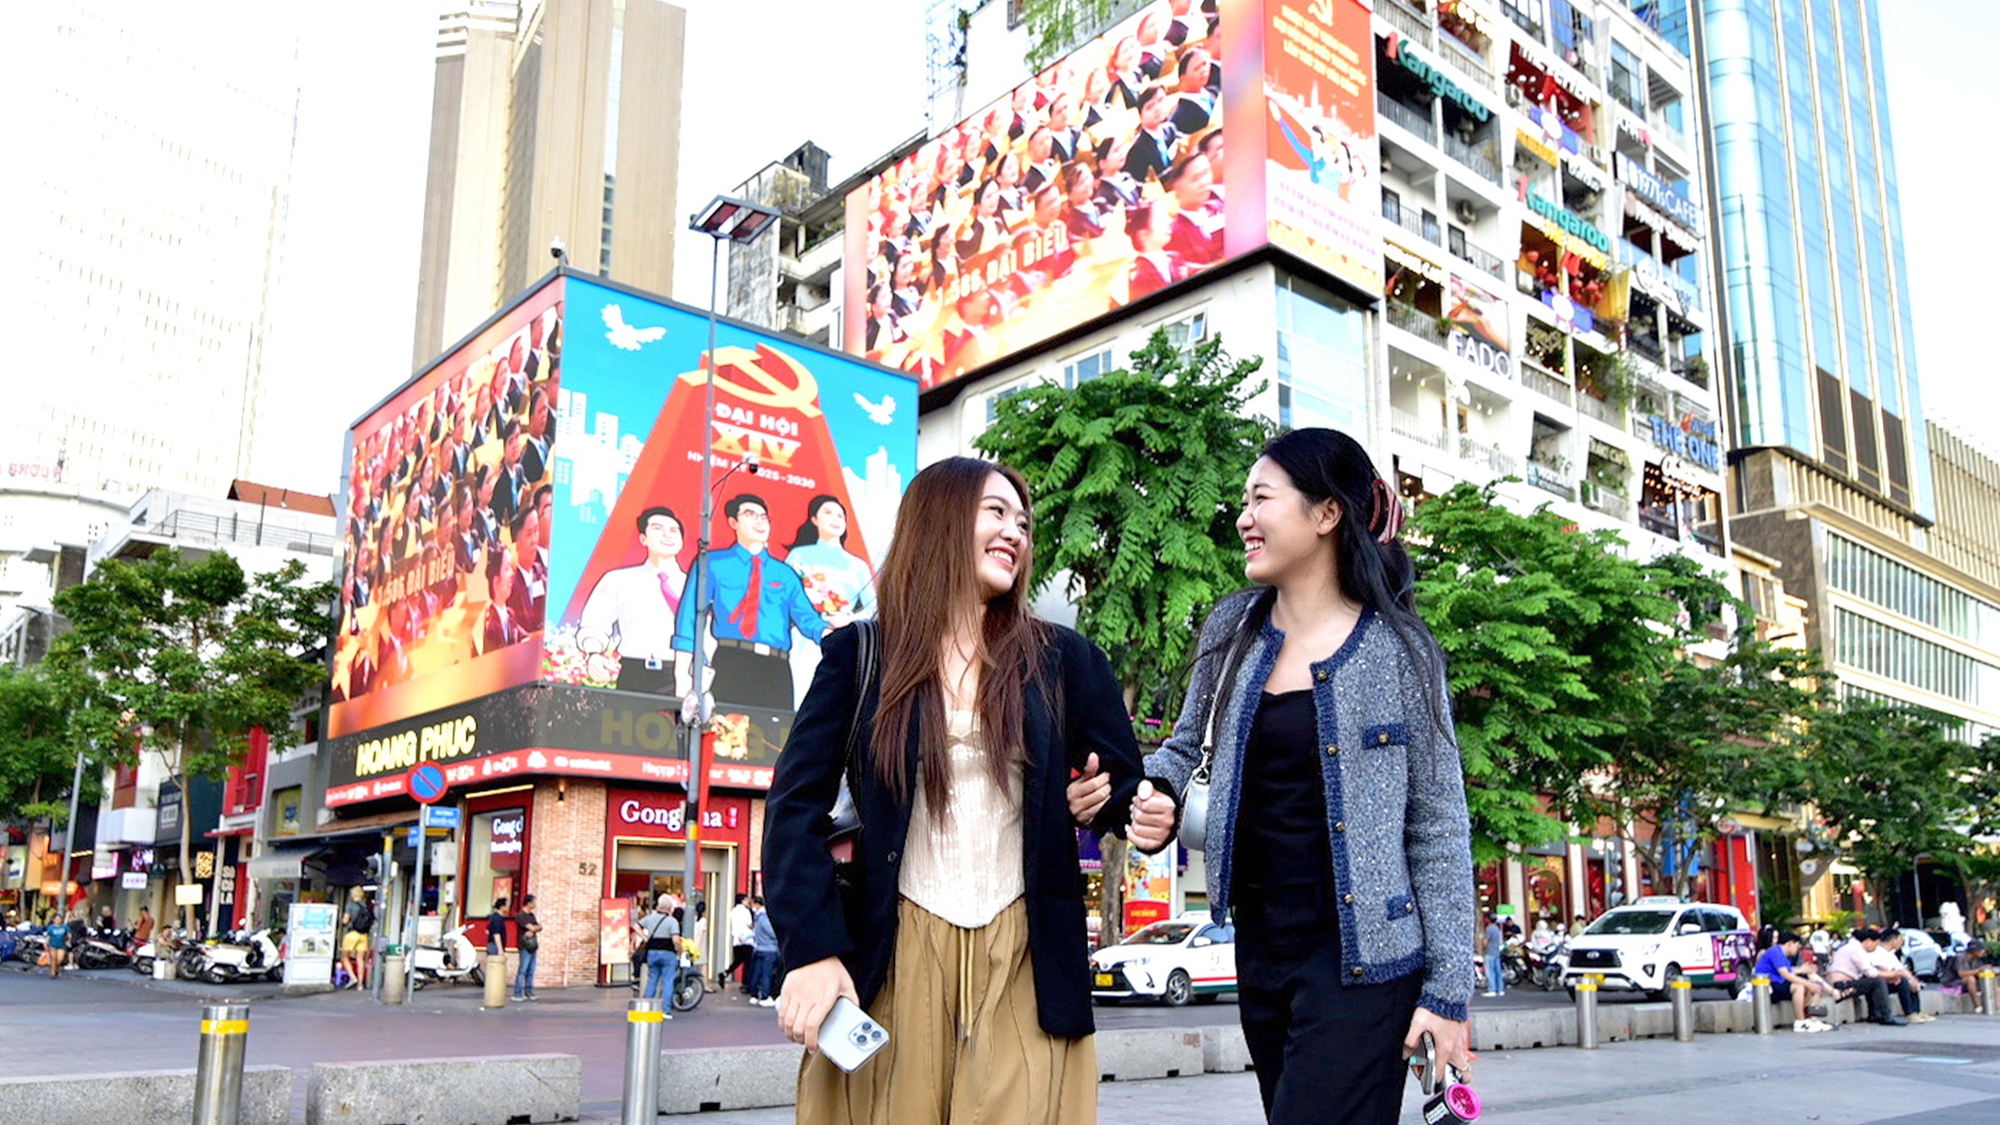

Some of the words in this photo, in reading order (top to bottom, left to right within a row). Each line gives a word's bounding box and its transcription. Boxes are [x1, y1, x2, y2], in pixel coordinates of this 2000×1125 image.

[1386, 31, 1489, 122] Kangaroo
[1517, 175, 1609, 254] Kangaroo
[710, 420, 801, 468] XIV
[714, 402, 753, 426] ĐẠI
[759, 414, 798, 436] HỘI
[1648, 415, 1684, 455] THE
[1687, 434, 1719, 475] ONE
[356, 730, 417, 776] HOANG
[420, 715, 477, 762] PHUC
[620, 800, 681, 832] Gong
[578, 862, 597, 876] 52
